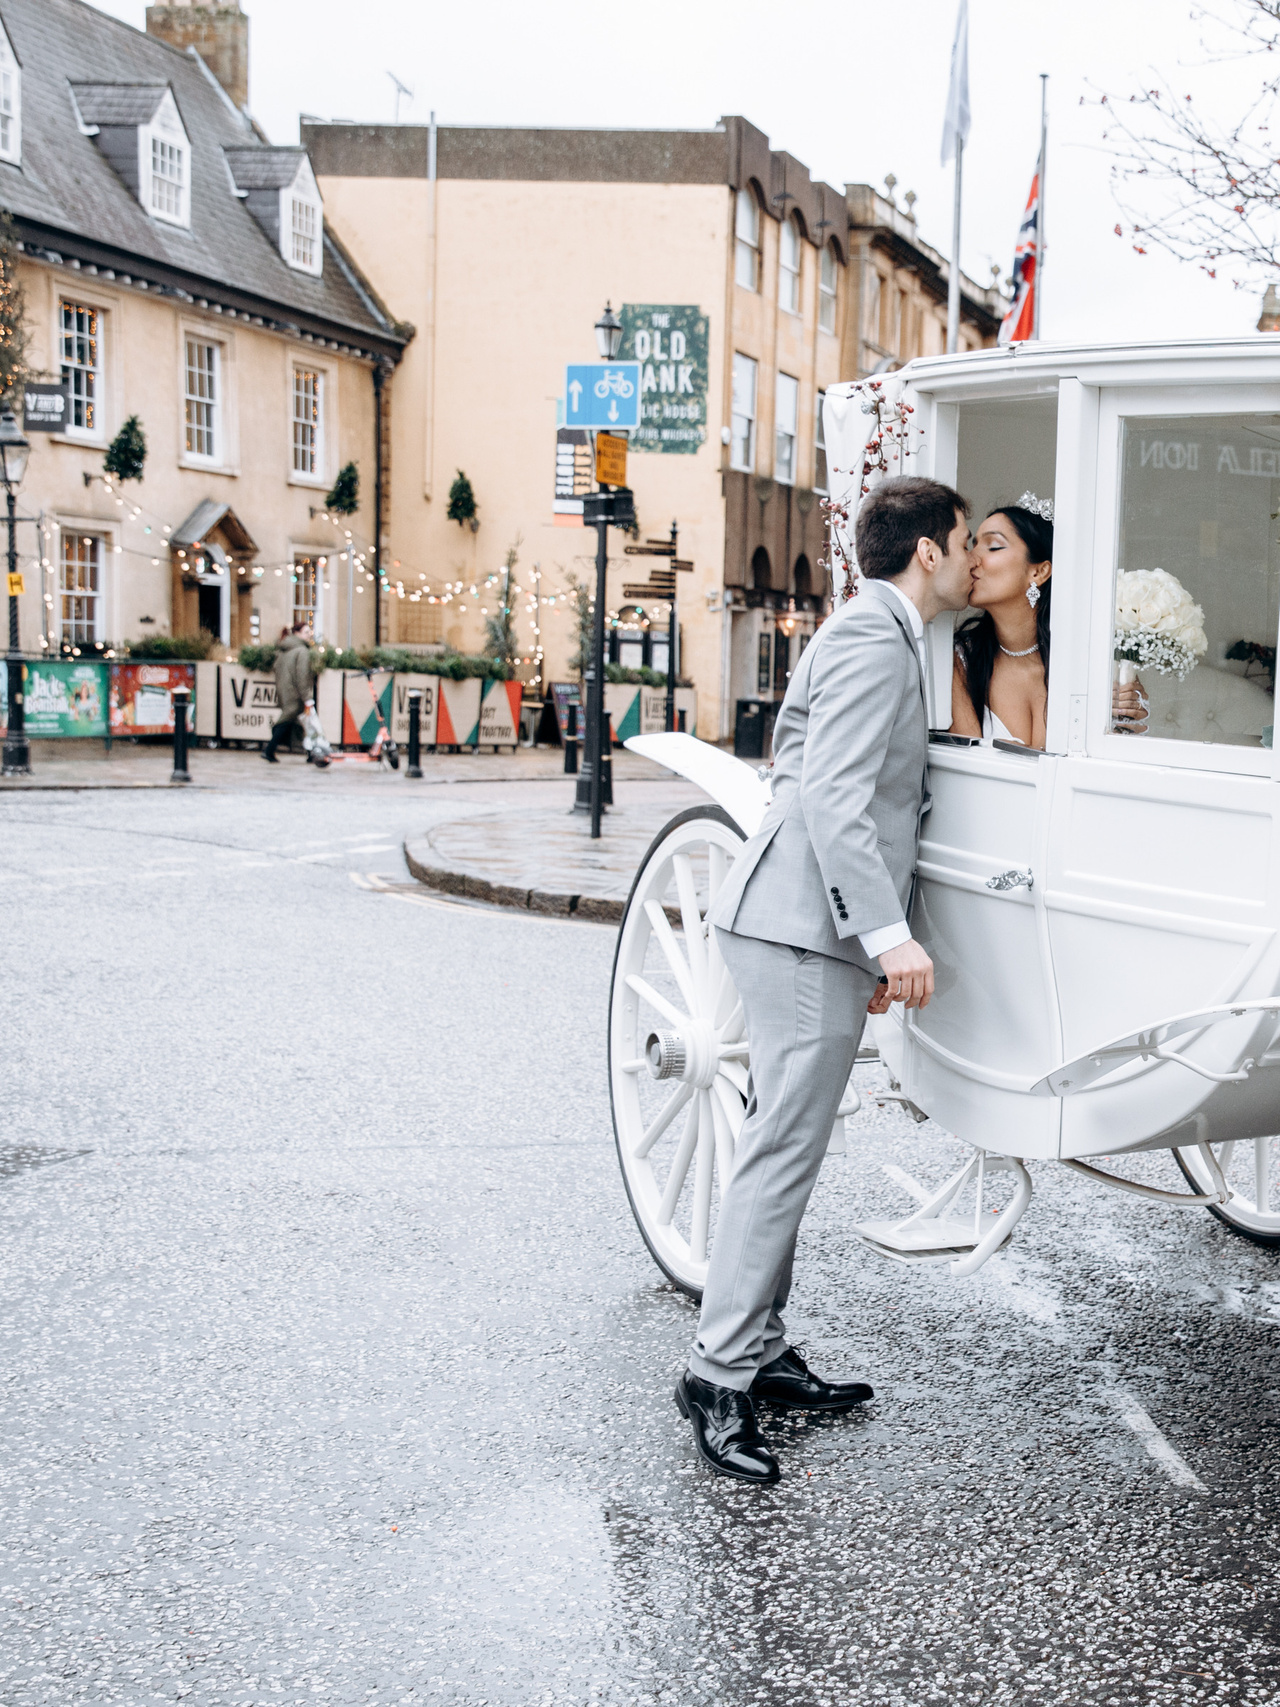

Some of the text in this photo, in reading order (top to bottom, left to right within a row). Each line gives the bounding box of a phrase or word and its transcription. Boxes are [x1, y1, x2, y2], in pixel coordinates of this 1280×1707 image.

[634, 329, 686, 361] OLD
[641, 364, 694, 394] ANK
[555, 443, 574, 495] ROUTE
[234, 713, 265, 727] SHOP
